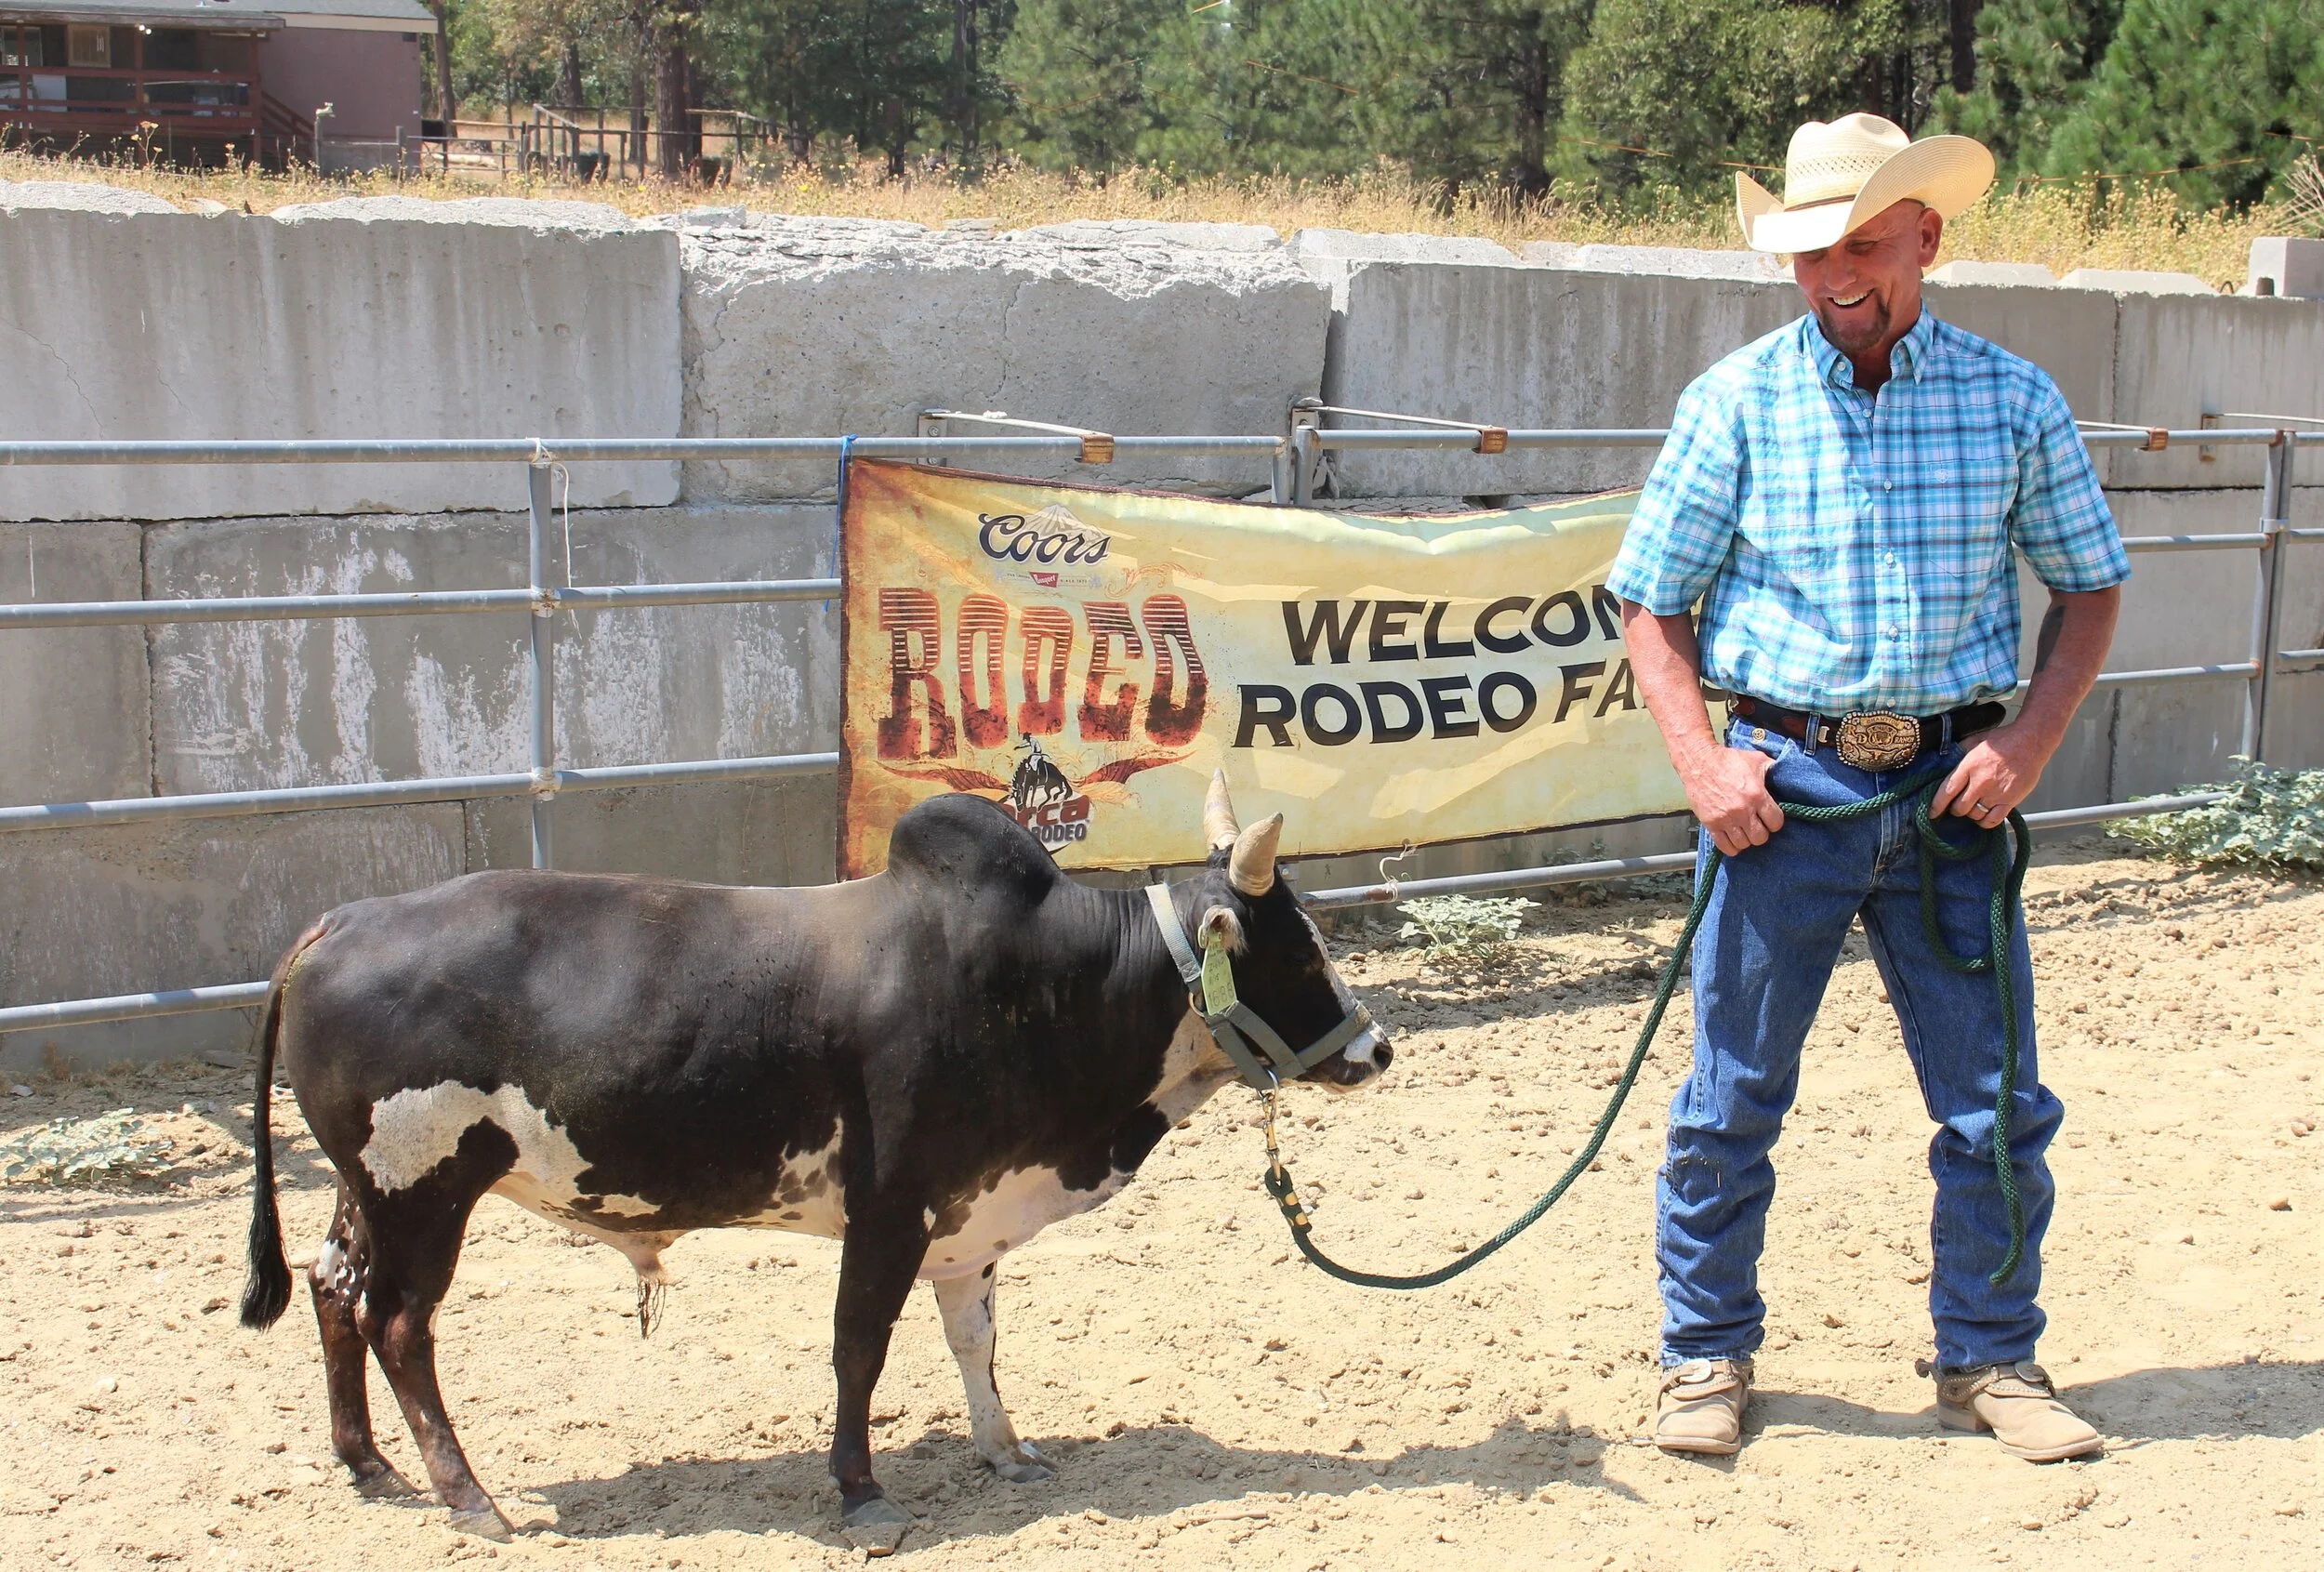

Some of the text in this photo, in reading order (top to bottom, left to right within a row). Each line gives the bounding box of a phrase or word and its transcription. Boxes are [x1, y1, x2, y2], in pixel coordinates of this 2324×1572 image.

[978, 513, 1112, 564] Coors
[1033, 574, 1056, 586] Banquet
[878, 587, 1209, 760] RODEO
[1232, 671, 1538, 747] RODEO
